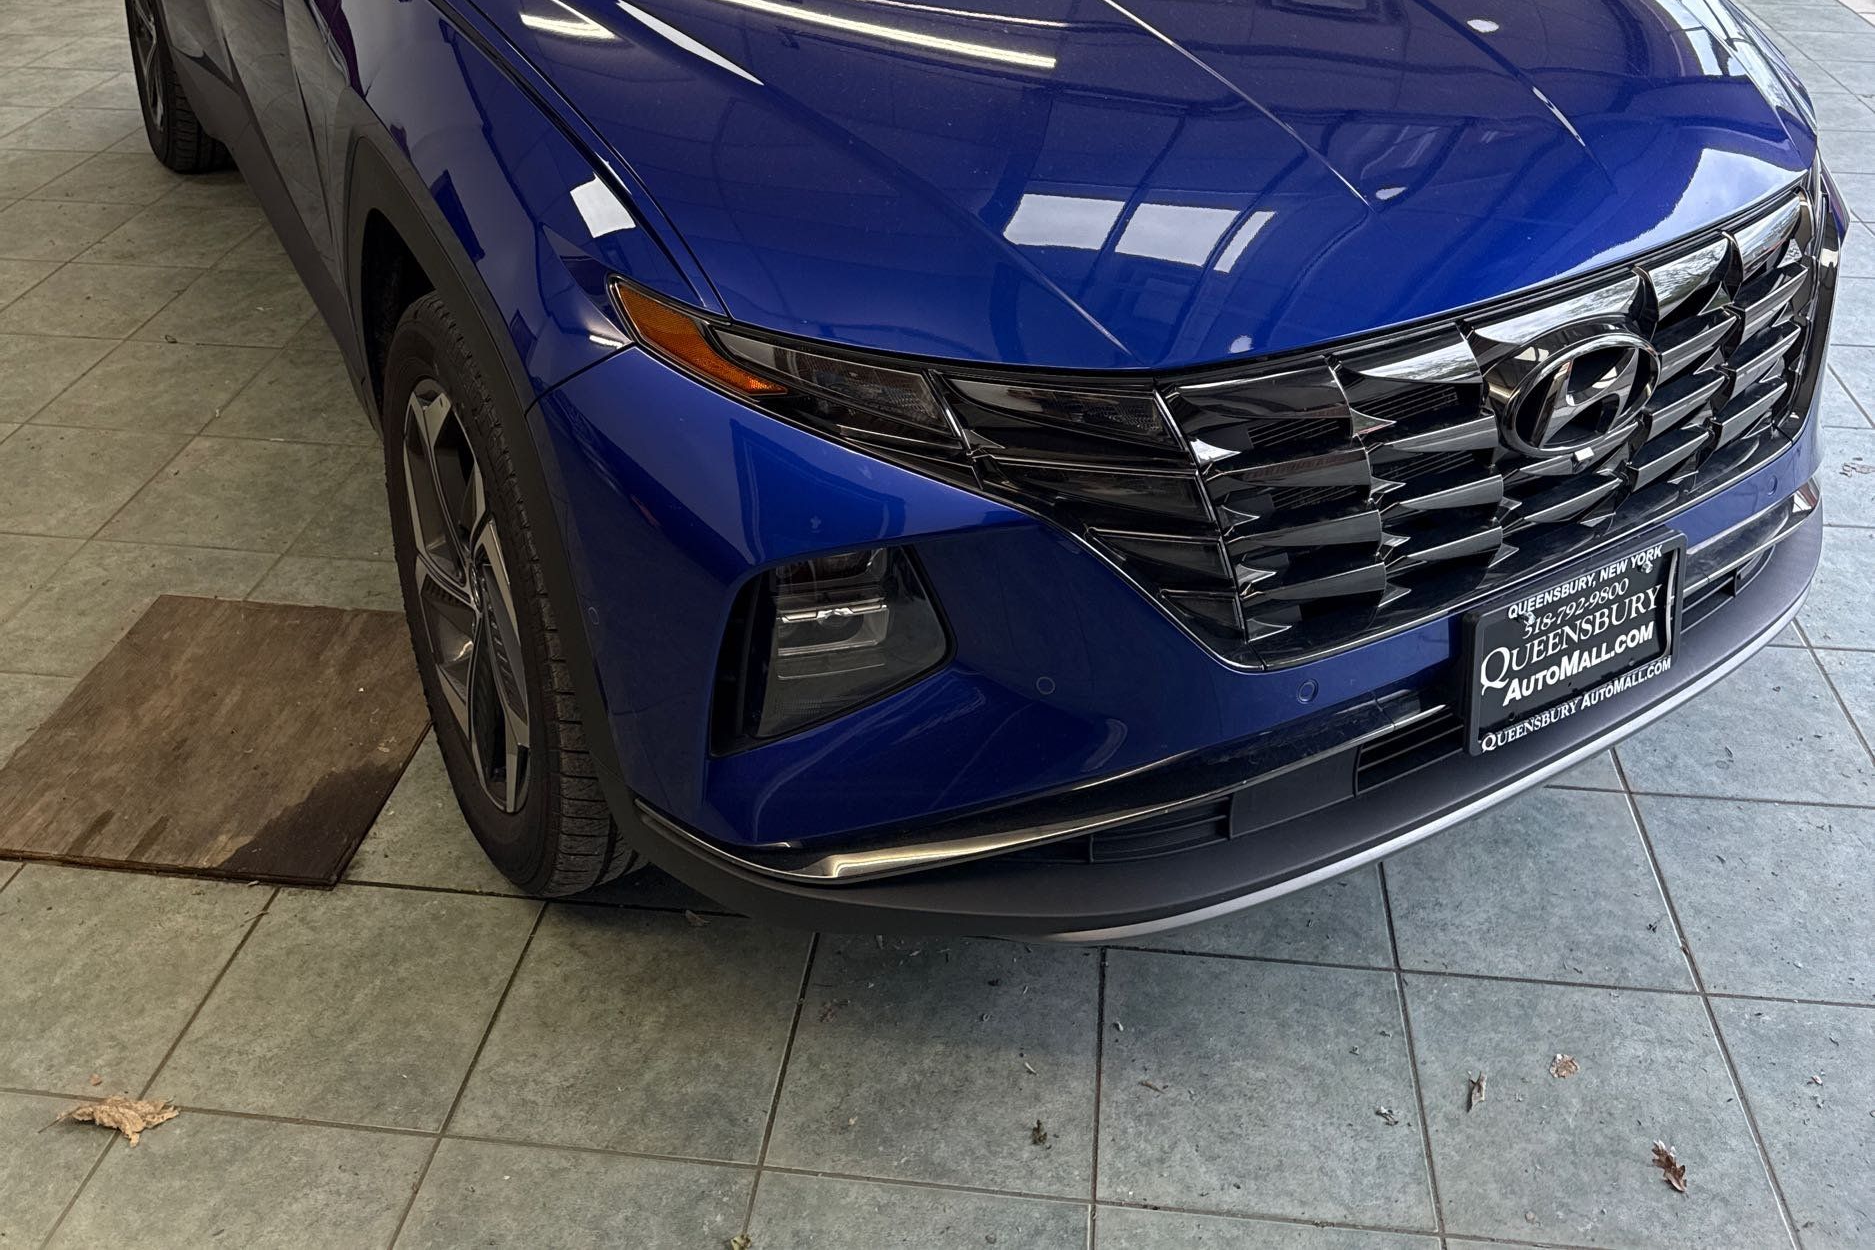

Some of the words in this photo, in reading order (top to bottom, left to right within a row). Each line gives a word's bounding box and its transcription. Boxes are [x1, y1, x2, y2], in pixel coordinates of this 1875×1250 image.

[1508, 573, 1597, 619] QUEENSBURY,
[1599, 559, 1628, 582] NEW
[1630, 545, 1663, 568] YORK
[1522, 578, 1629, 639] 518-792-9800
[1480, 584, 1663, 695] QUEENSBURY
[1481, 697, 1580, 753] QUEENSBURY
